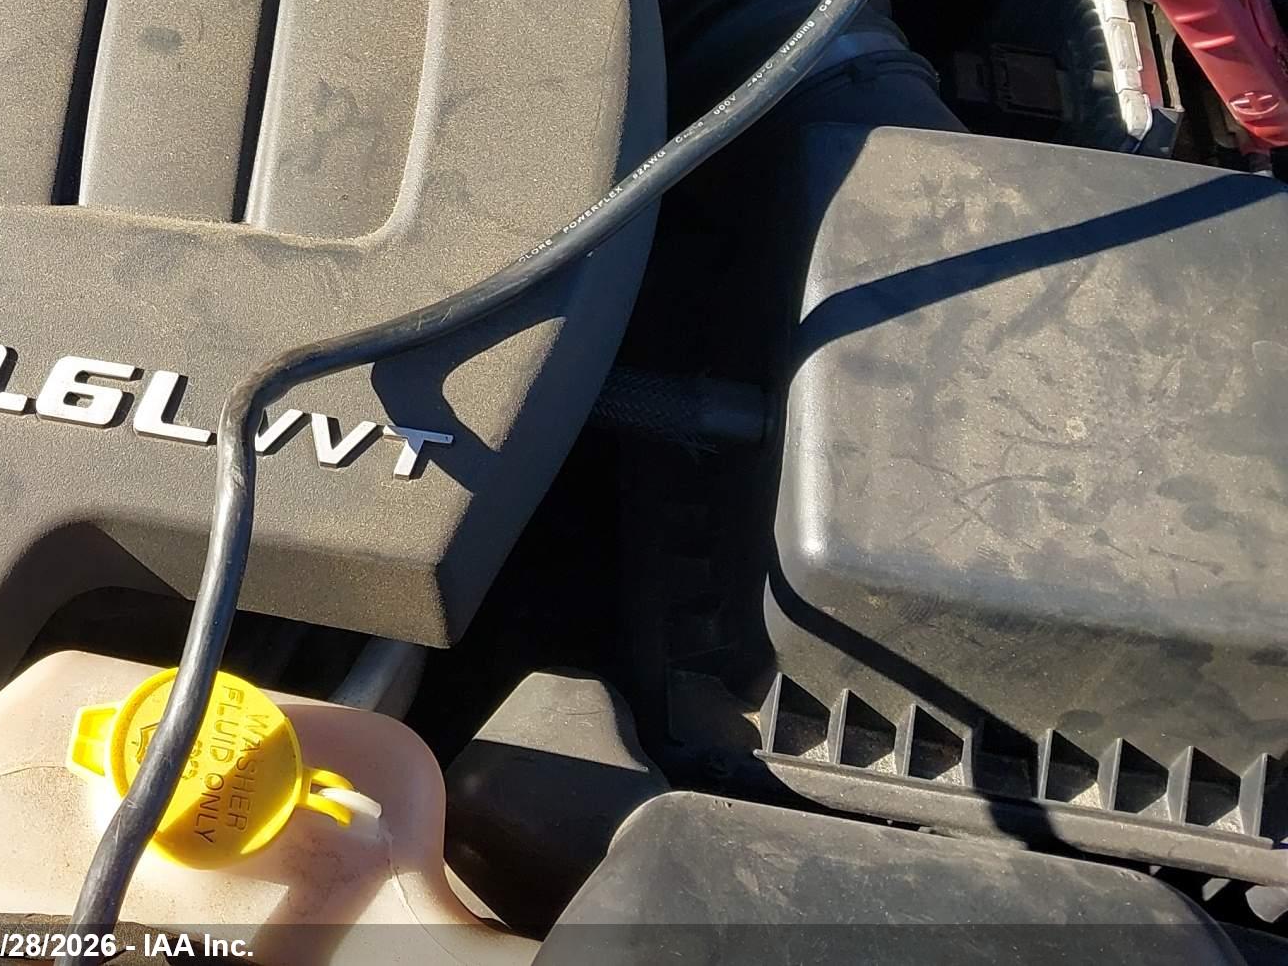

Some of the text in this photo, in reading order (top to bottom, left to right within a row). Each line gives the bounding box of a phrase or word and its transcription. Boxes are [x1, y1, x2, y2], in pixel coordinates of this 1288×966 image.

[562, 185, 623, 234] POWERFLEX
[779, 20, 816, 54] Welding
[194, 685, 245, 844] FLUID ONLY
[227, 713, 270, 831] WASHER
